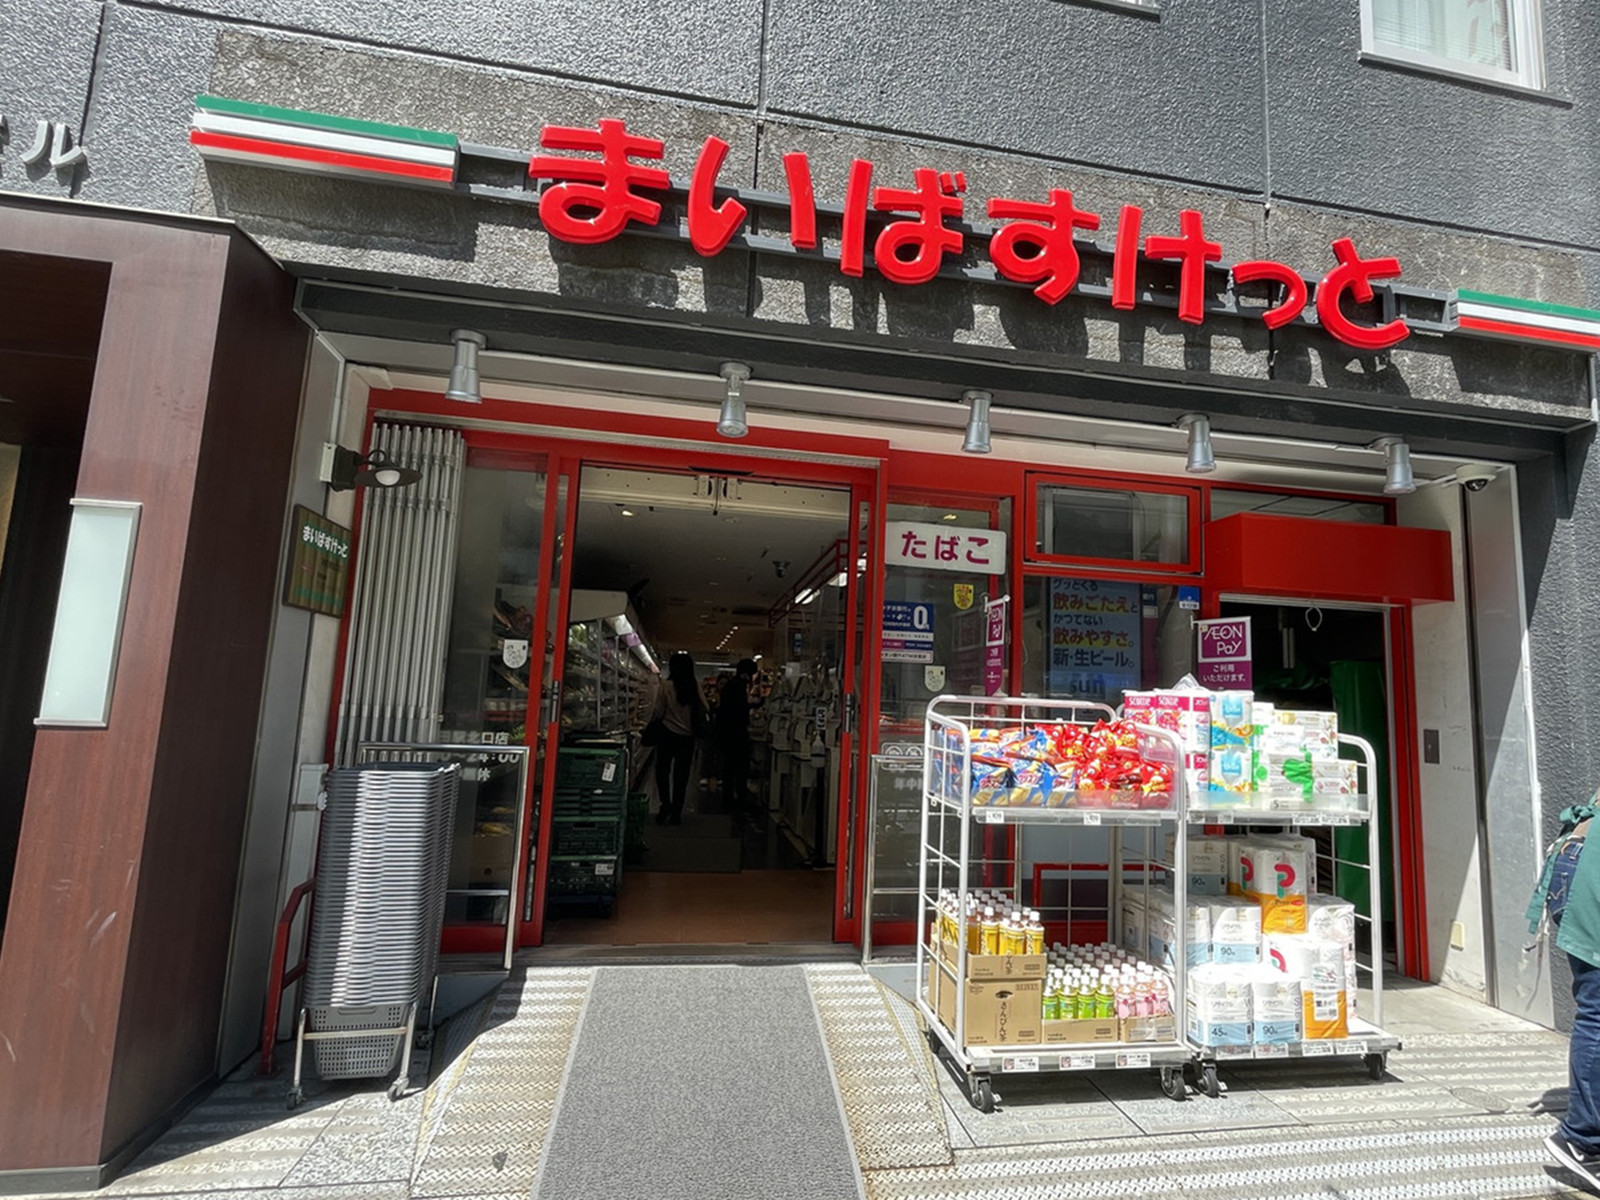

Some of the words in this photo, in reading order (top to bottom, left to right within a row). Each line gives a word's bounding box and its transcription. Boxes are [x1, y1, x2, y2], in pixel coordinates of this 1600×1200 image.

[0, 113, 82, 166] ル
[528, 117, 1410, 350] まいばすけっと
[302, 524, 348, 559] まいばすけっと
[901, 530, 991, 565] たばこ
[1053, 592, 1139, 614] 飲みごたえと
[1053, 613, 1104, 626] かつてない
[1053, 626, 1135, 648] 飲みやすさ。
